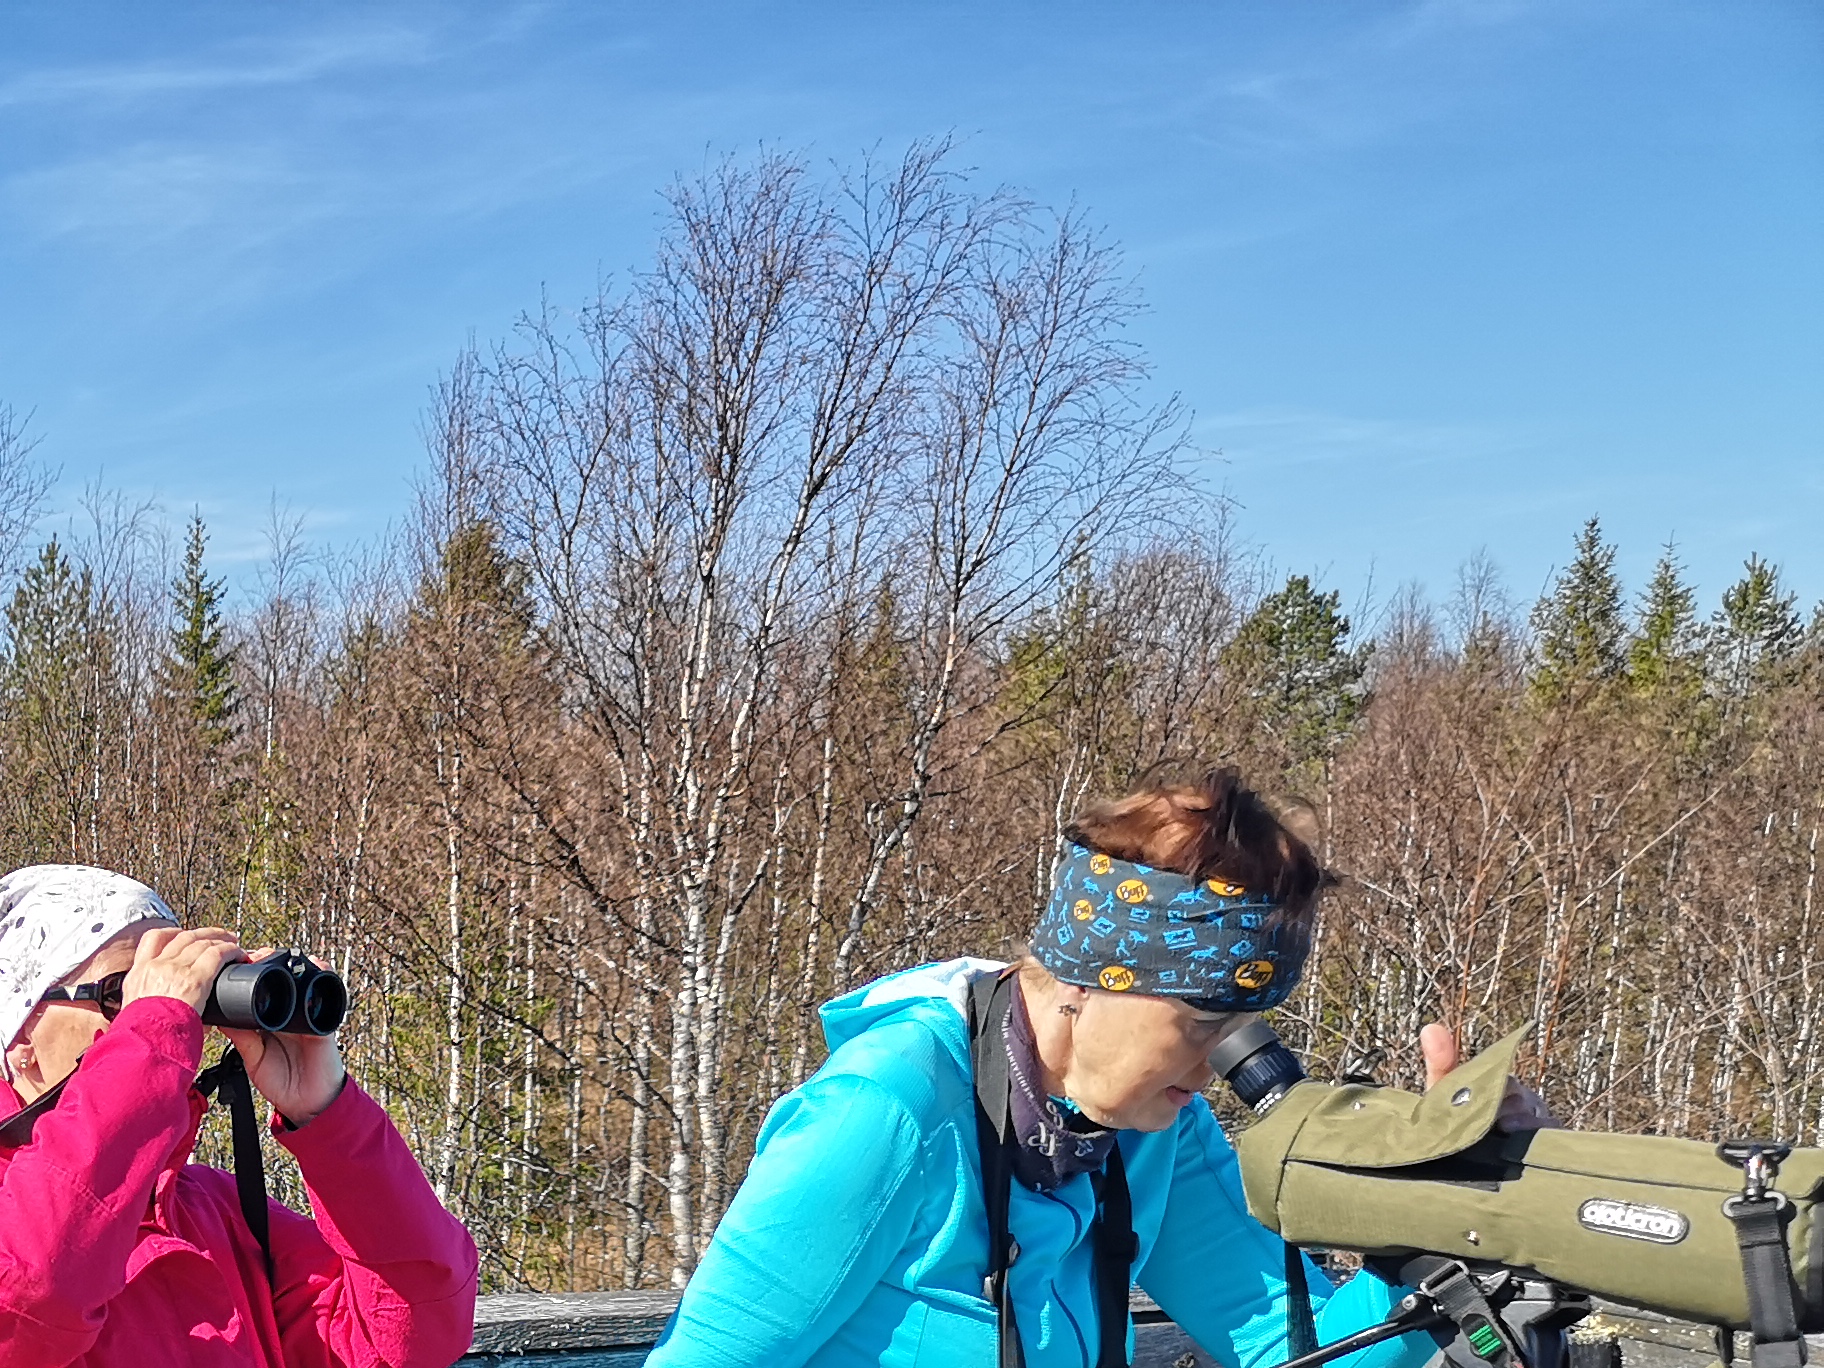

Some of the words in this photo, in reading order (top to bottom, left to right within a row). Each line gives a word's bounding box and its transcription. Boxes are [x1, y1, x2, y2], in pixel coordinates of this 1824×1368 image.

[1119, 884, 1145, 900] Buff
[1102, 969, 1132, 989] Buff
[1582, 1203, 1681, 1239] opticron
